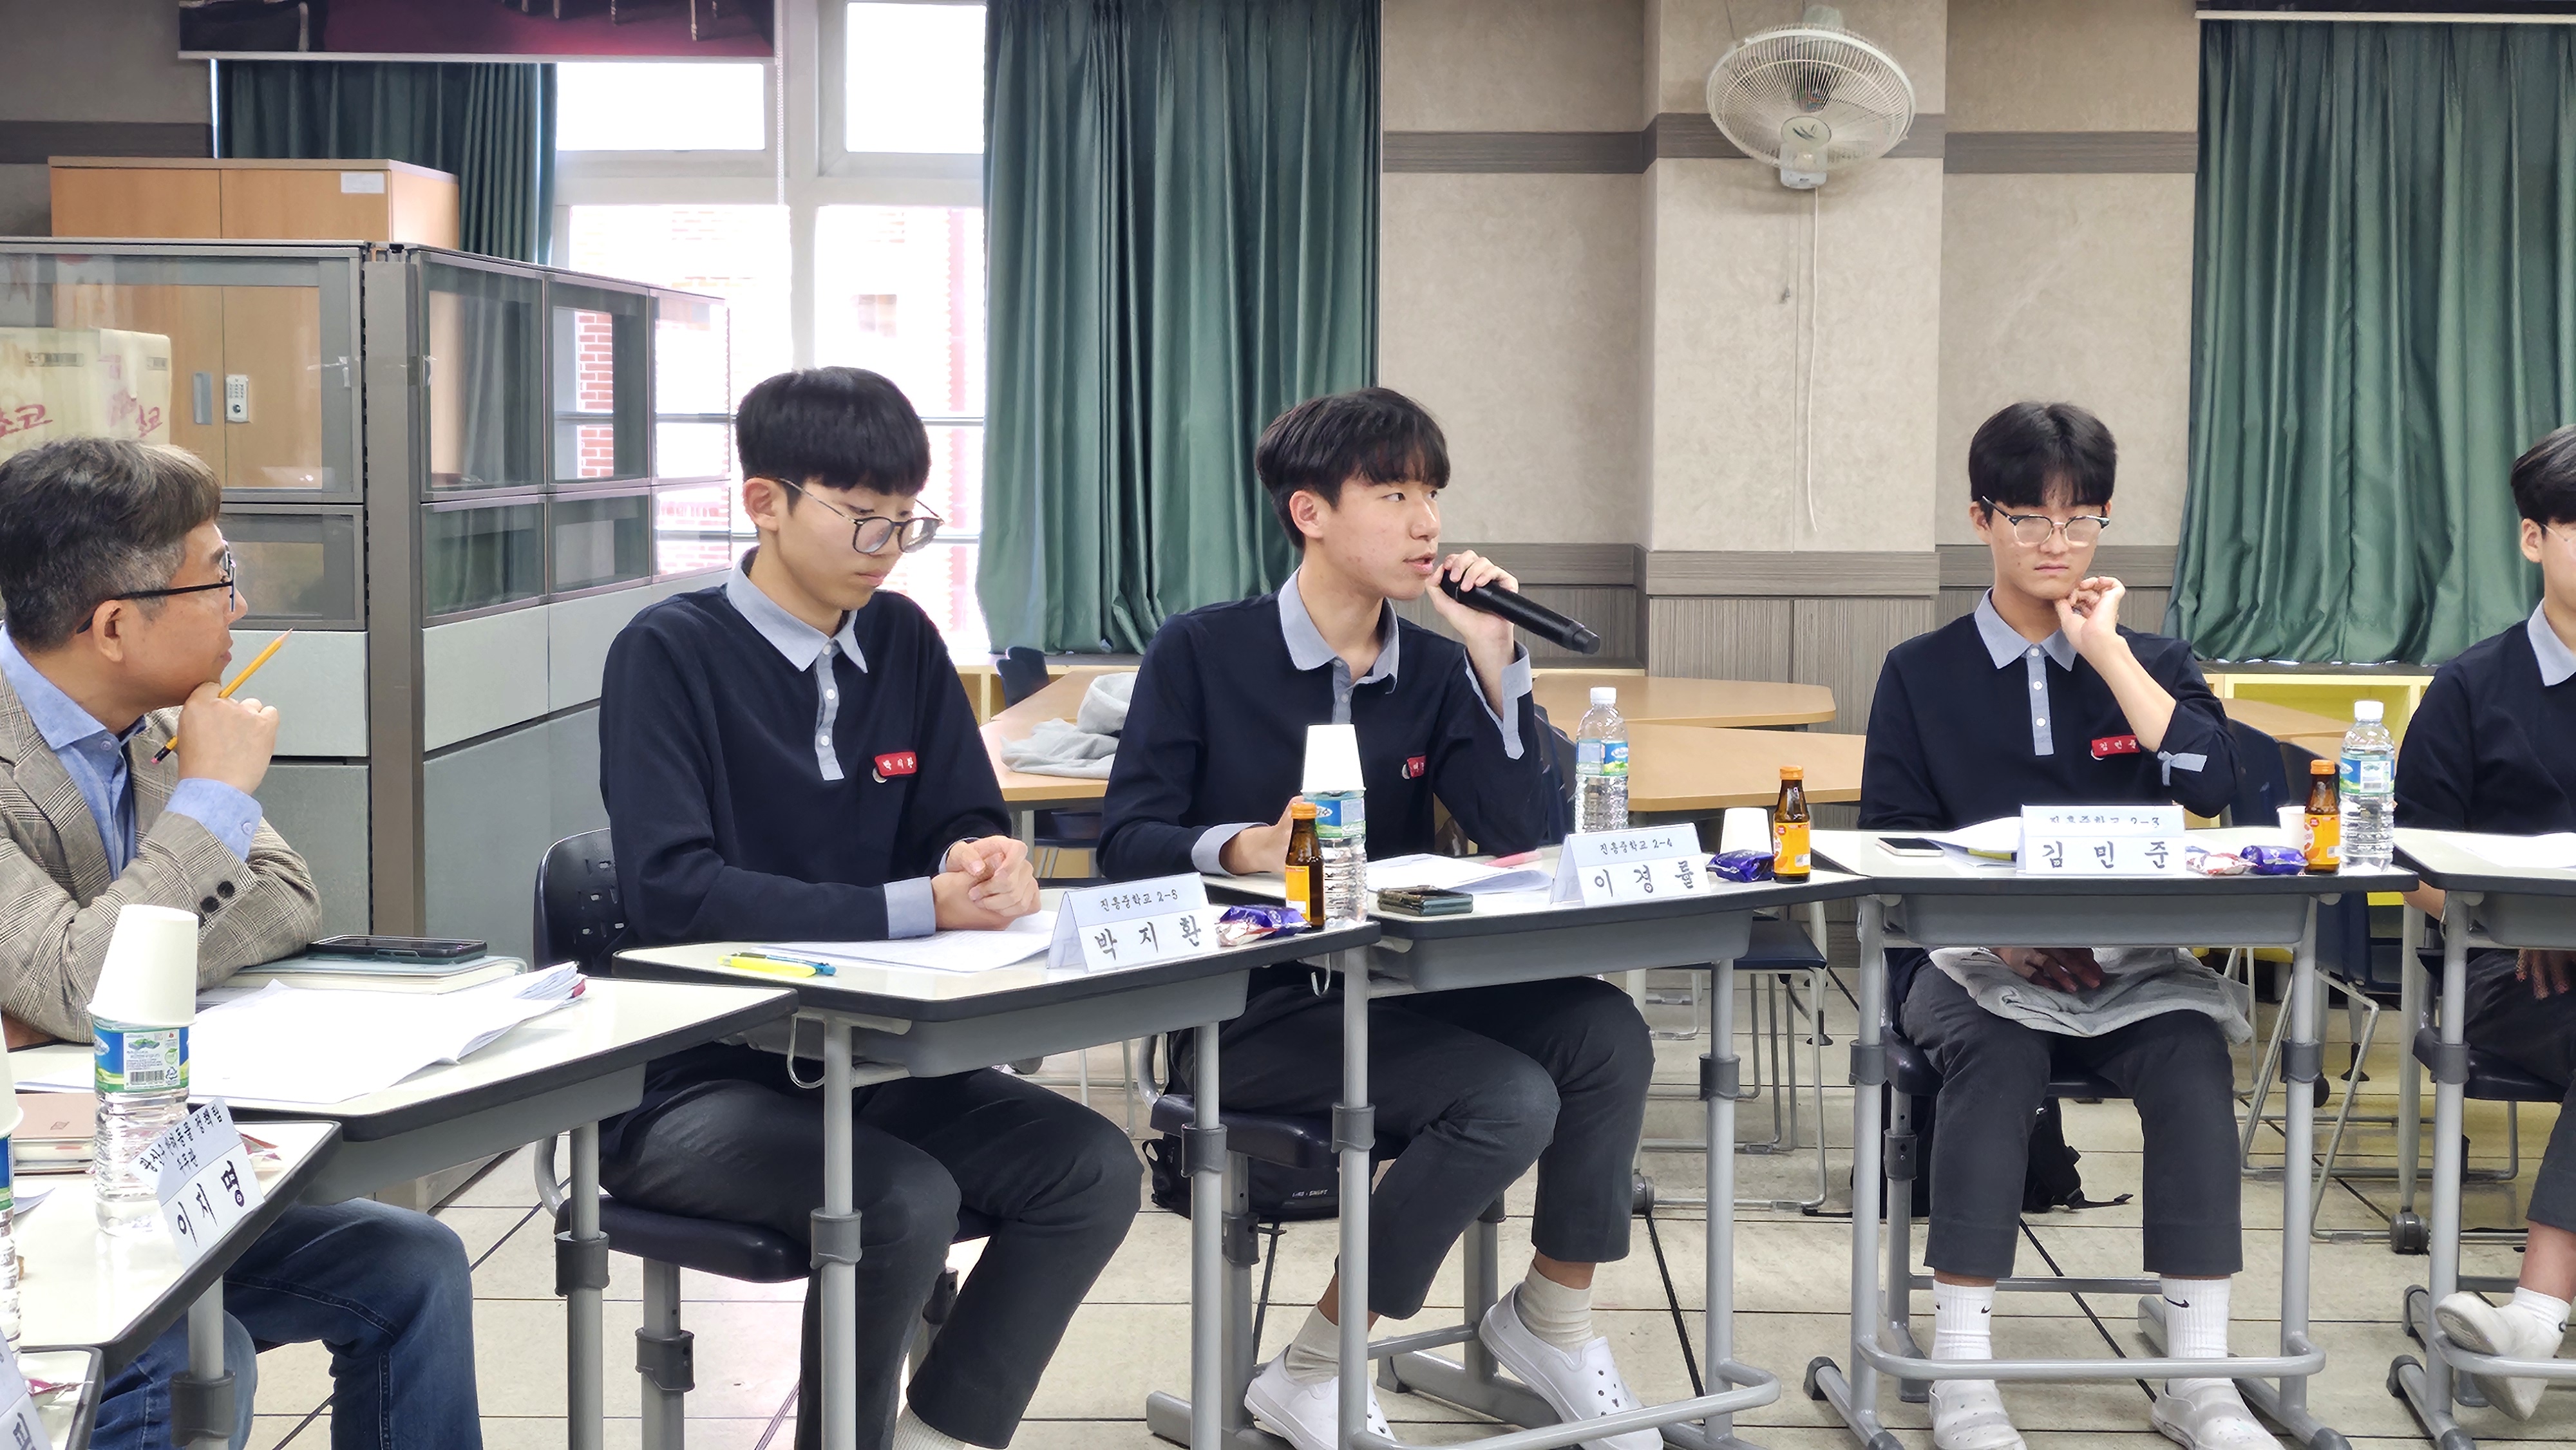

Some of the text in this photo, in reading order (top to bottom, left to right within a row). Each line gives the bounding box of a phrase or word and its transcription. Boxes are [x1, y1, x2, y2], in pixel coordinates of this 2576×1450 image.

[1653, 837, 1673, 850] 2-4
[2041, 840, 2170, 870] 김민준
[1094, 914, 1202, 961] 박지환
[176, 1160, 245, 1248] 이지명
